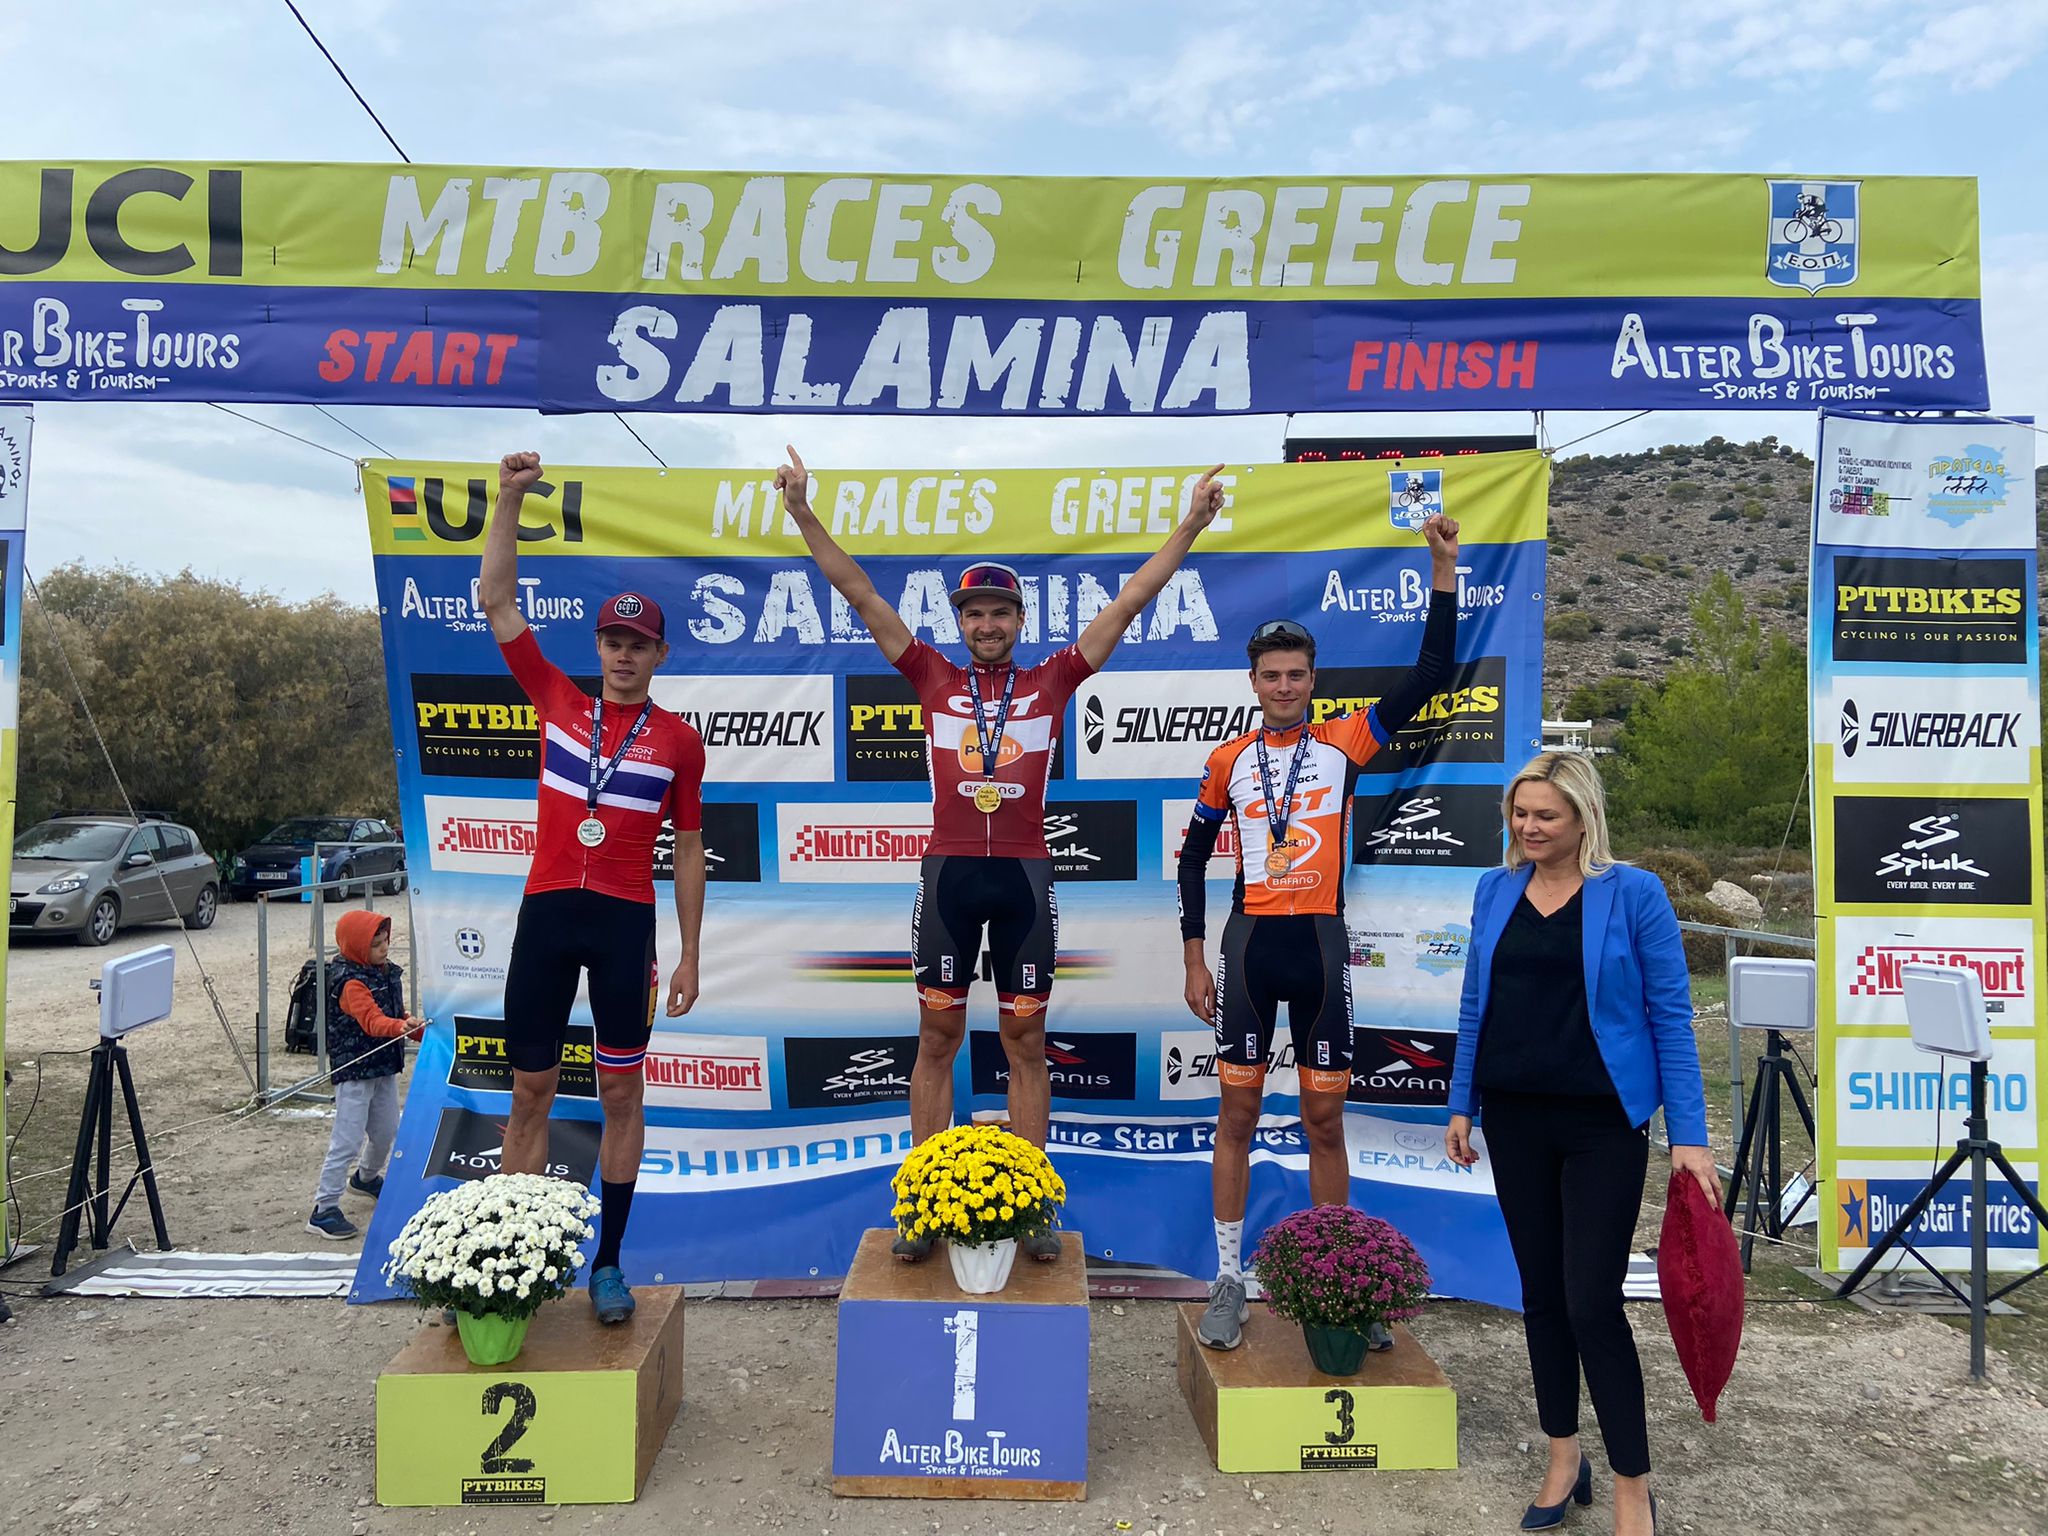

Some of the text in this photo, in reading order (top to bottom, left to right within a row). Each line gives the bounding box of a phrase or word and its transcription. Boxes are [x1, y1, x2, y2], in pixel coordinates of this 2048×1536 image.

[376, 171, 1532, 290] MTB RACES GREECE
[33, 297, 127, 368] BIKE
[121, 298, 240, 369] TOURS
[1610, 312, 1956, 380] ALTER BIKE TOURS
[318, 328, 518, 386] START
[596, 303, 1251, 413] SALAMINA
[1347, 340, 1539, 391] FINISH
[66, 369, 80, 390] &
[1786, 381, 1798, 400] &
[832, 477, 997, 537] RACES
[401, 576, 468, 619] ALTER
[517, 577, 585, 620] TOURS
[1320, 569, 1396, 612] ALTER
[1455, 565, 1505, 609] TOURS
[1837, 585, 2022, 615] PTTBIKES
[618, 602, 639, 612] SCOTT
[1841, 631, 2018, 642] CYCLING IS OUR PASSION
[1389, 742, 1401, 751] IS
[1434, 731, 1494, 745] PASSION
[1866, 712, 2022, 748] SILVERBACK
[425, 746, 533, 758] CYCLING IS OUR
[855, 750, 920, 759] CYCLING
[457, 822, 537, 856] NutriSp
[814, 829, 932, 862] NutriSpor
[1366, 826, 1465, 846] Spiuk
[1415, 848, 1435, 856] EVERY
[1875, 851, 1991, 878] Spiuk
[1054, 864, 1074, 872] EVERY
[1272, 875, 1314, 886] BAFANG
[1886, 880, 1908, 890] EVERY
[1932, 881, 1956, 890] EVERY
[943, 958, 952, 981] FILA
[1025, 965, 1035, 987] FILA
[457, 1035, 593, 1064] PTTES
[1247, 1035, 1256, 1058] FILA
[1318, 1042, 1328, 1063] FILA
[457, 1068, 504, 1076] CYCLING
[646, 1056, 762, 1091] NutriSport
[995, 1070, 1111, 1086] KANIS
[1848, 1071, 2028, 1112] SHIMANO
[1050, 1125, 1102, 1147] lue
[1115, 1125, 1180, 1151] Star
[449, 1151, 569, 1176] KOVIS
[943, 1310, 978, 1421] 1
[481, 1381, 537, 1475] 2
[1324, 1388, 1355, 1445] 3
[879, 1428, 1041, 1467] ALTER BIKE TOURS
[1302, 1446, 1376, 1458] PTTBIKES
[959, 1465, 967, 1475] &
[463, 1479, 544, 1492] PTTBIKES
